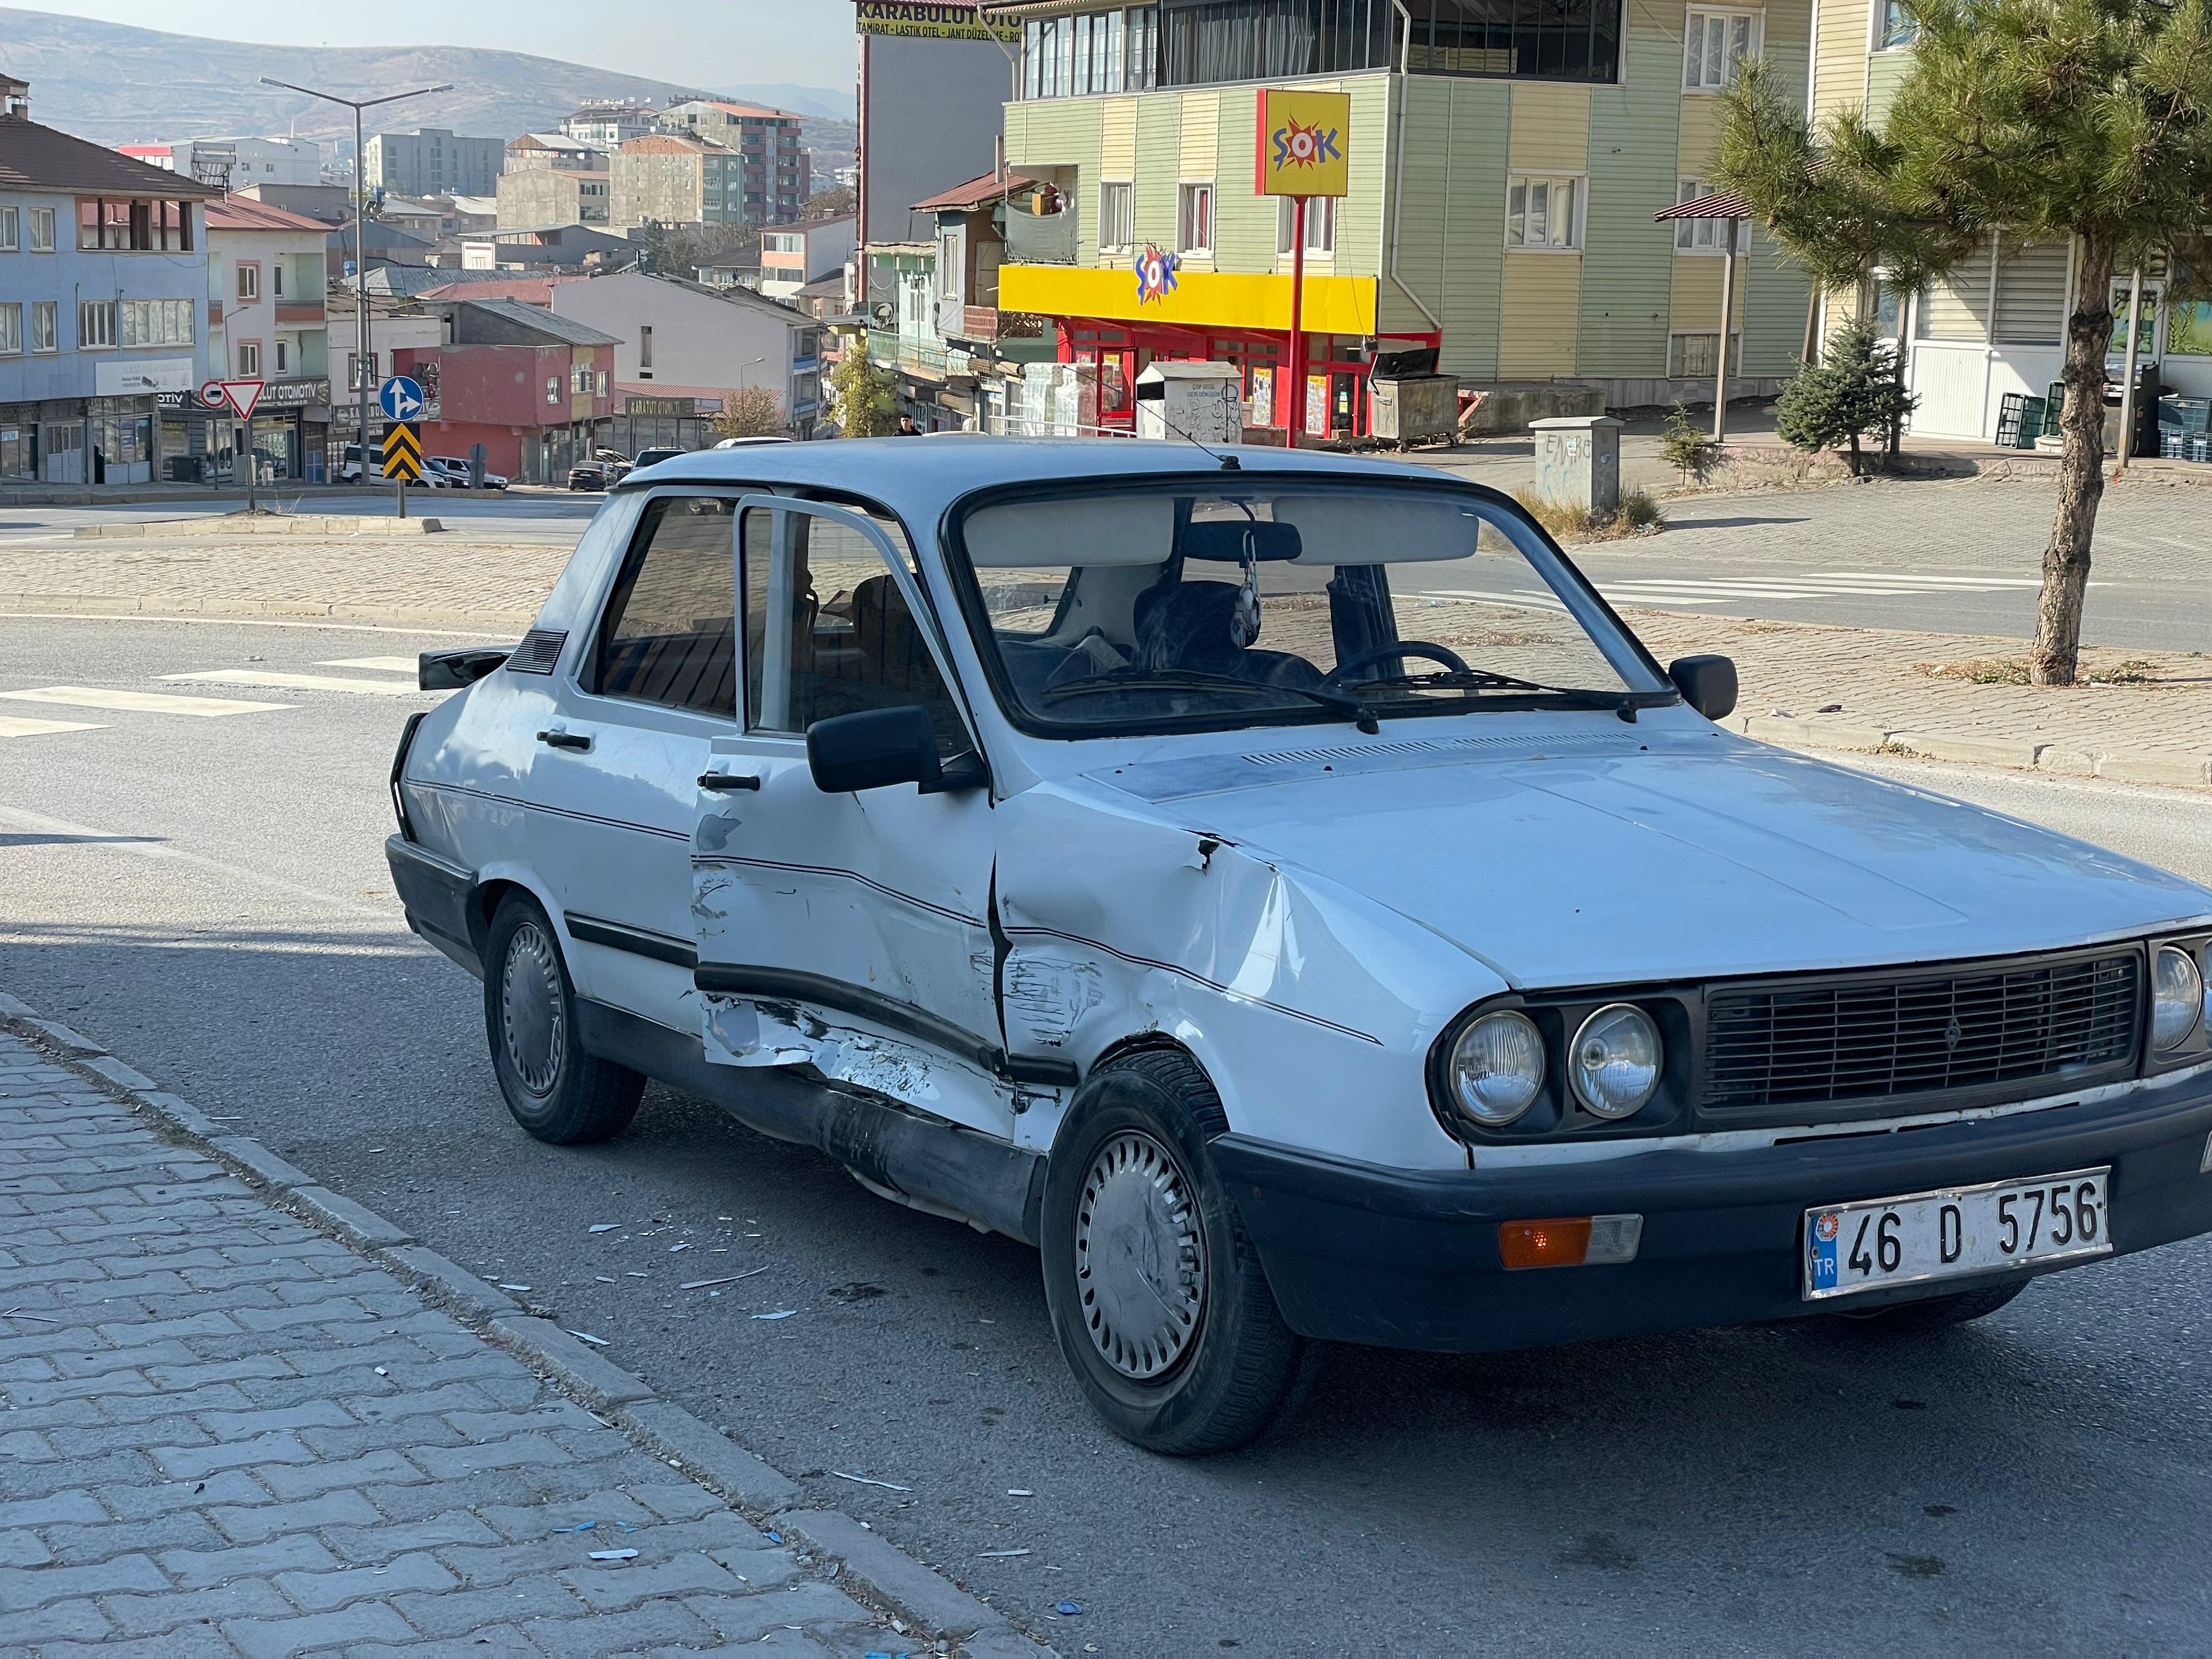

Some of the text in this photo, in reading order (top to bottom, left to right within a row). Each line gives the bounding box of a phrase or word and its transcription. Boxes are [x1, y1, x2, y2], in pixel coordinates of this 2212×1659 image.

[857, 2, 977, 25] KARABULUT
[923, 26, 939, 38] OTEL
[947, 28, 964, 40] JANT
[1273, 127, 1341, 171] ŞOK
[1136, 251, 1178, 306] ŞOK
[278, 382, 316, 399] OTOMOTİV
[1849, 1181, 2098, 1276] 46 D 5756
[1814, 1257, 1835, 1277] TR
